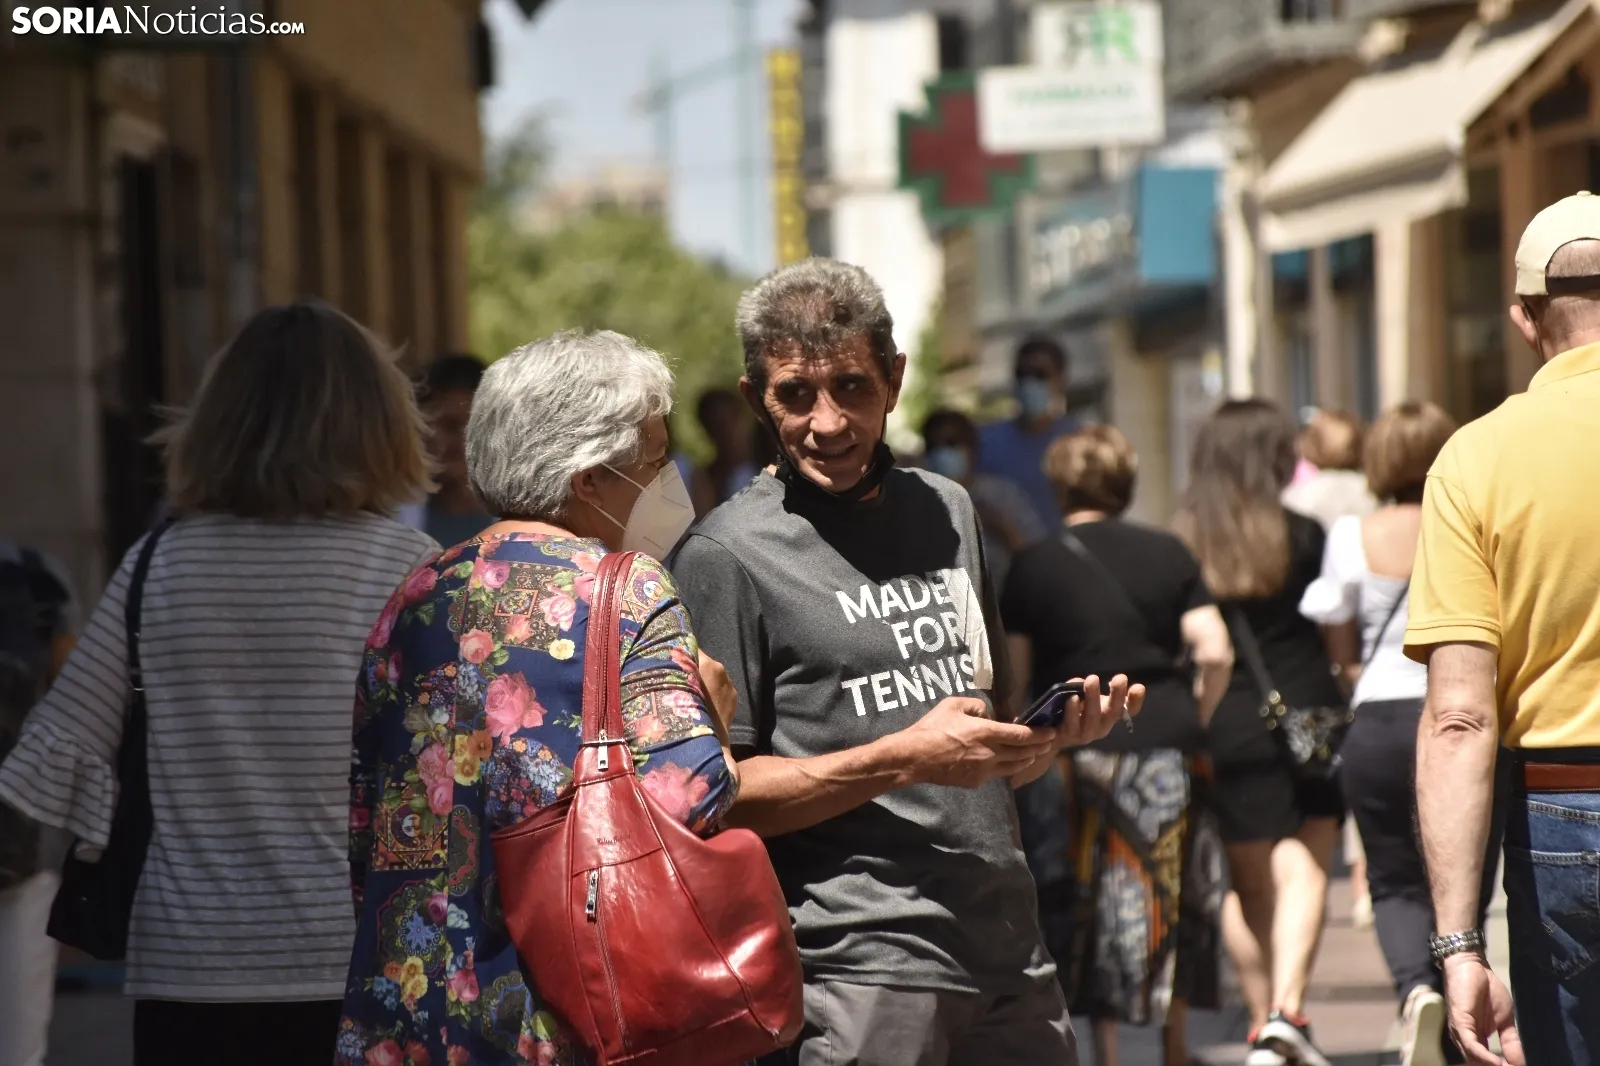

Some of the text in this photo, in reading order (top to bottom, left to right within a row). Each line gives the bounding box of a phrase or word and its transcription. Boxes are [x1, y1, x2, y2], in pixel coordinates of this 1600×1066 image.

[835, 569, 953, 624] MADE
[891, 611, 967, 660] FOR
[841, 653, 976, 717] TENNIS
